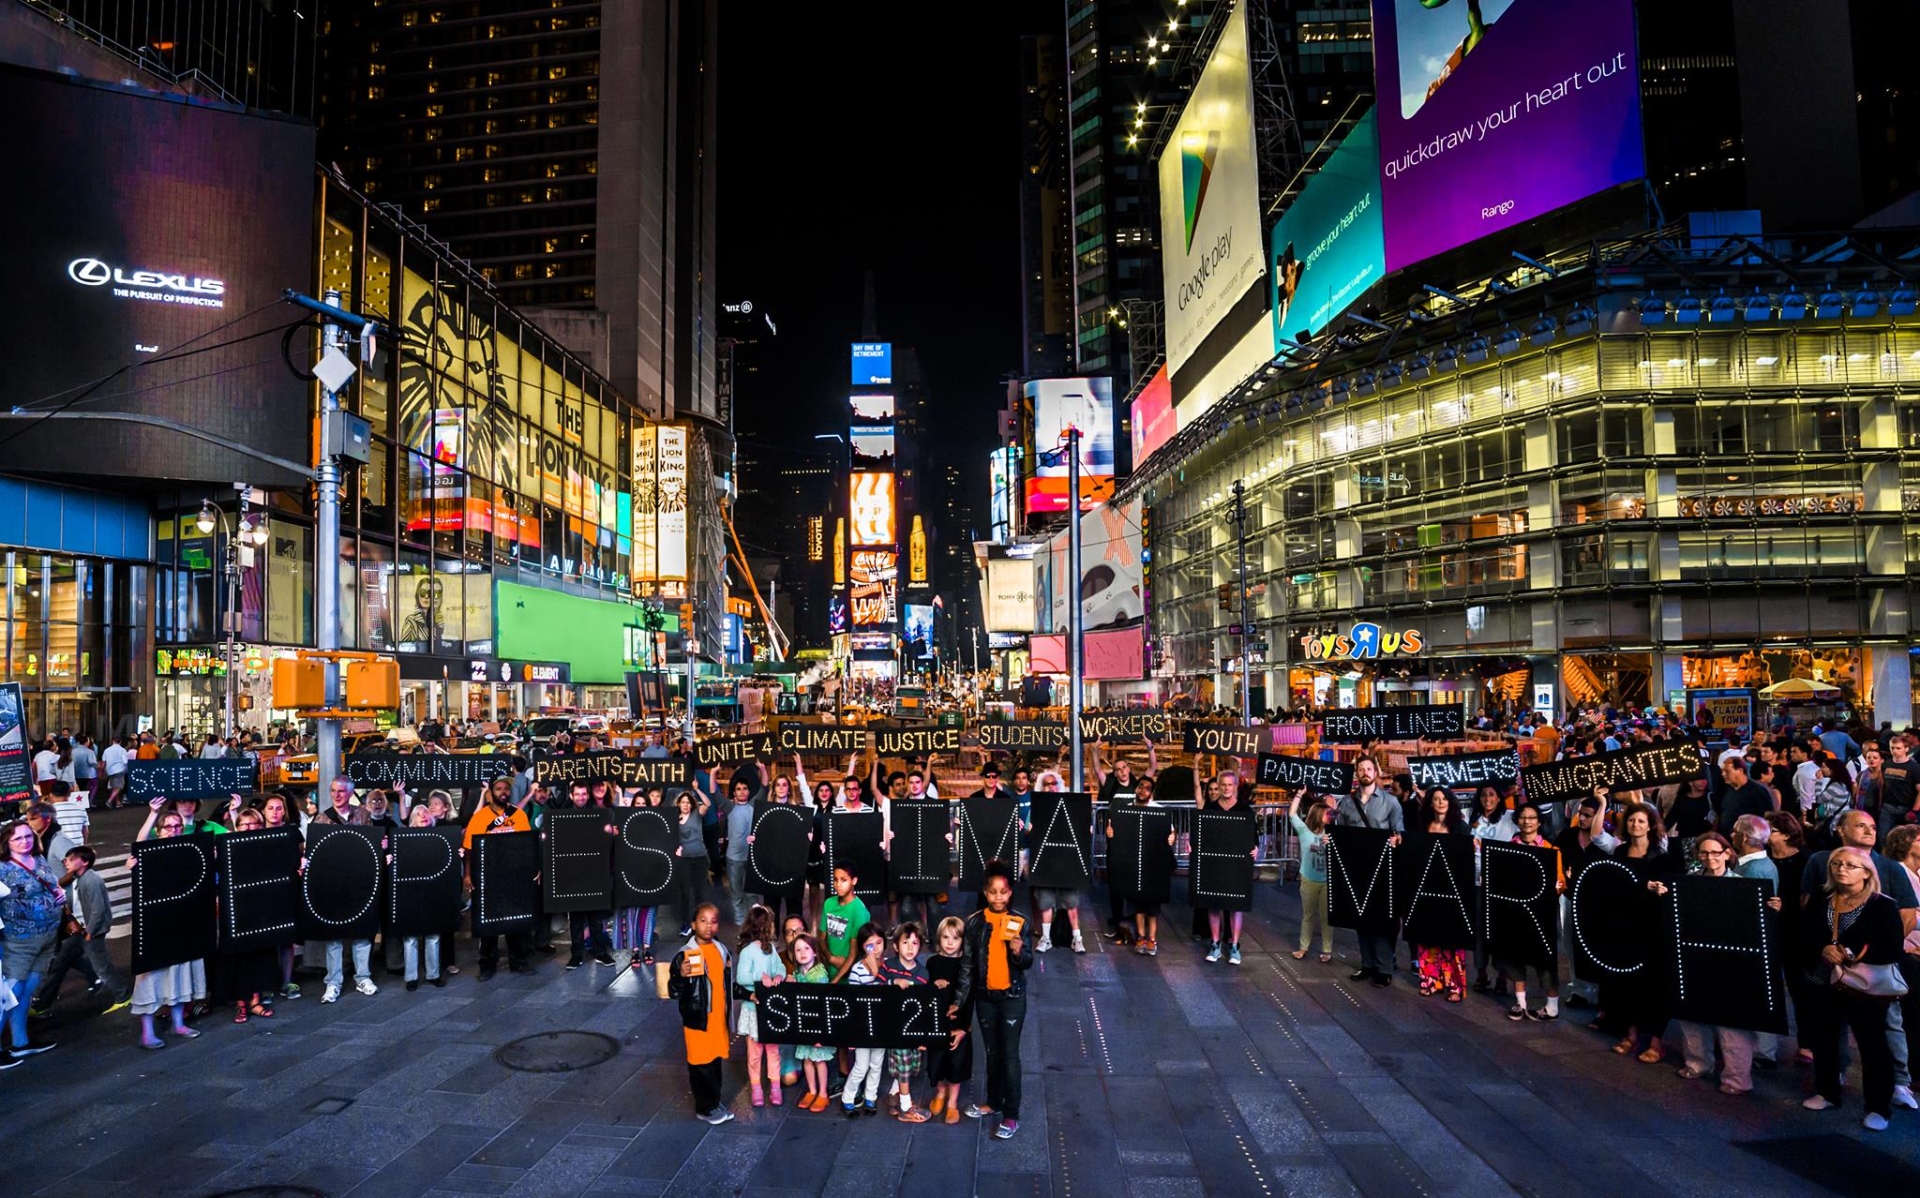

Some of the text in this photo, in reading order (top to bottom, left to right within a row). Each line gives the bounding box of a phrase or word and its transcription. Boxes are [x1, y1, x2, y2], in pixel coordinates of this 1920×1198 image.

[1385, 52, 1627, 179] quickdraw your heart out
[1481, 199, 1514, 220] Rango
[1306, 193, 1371, 270] groove your heart out
[114, 268, 226, 295] LEXUS
[1178, 226, 1233, 312] Google play
[113, 288, 223, 308] THE PURSUIT OF PERFECTION
[718, 358, 730, 422] TIMES
[555, 397, 582, 436] THE
[661, 447, 683, 458] LION
[664, 438, 679, 446] THE
[660, 460, 685, 473] KING
[815, 515, 823, 561] NOVOTEL
[532, 665, 559, 680] ELEMENT
[1713, 705, 1748, 715] FLAVOR
[980, 724, 1065, 747] STUDENTS
[1079, 713, 1165, 738] WORKERS
[1325, 710, 1460, 737] FRONT LINES
[0, 742, 24, 751] Cruelty
[698, 737, 773, 764] UNITE 4
[781, 729, 866, 750] CLIMATE
[878, 729, 960, 753] JUSTICE
[1193, 728, 1259, 753] YOUTH
[129, 765, 252, 794] SCIENCE
[348, 758, 509, 783] COMMUNITIES
[536, 754, 622, 781] PARENTS
[622, 761, 685, 783] FAITH
[1263, 759, 1344, 790] PADRES
[1409, 755, 1517, 785] FARMERS
[1524, 743, 1701, 799] INMIGRANTES
[766, 993, 947, 1037] SEPT 21
